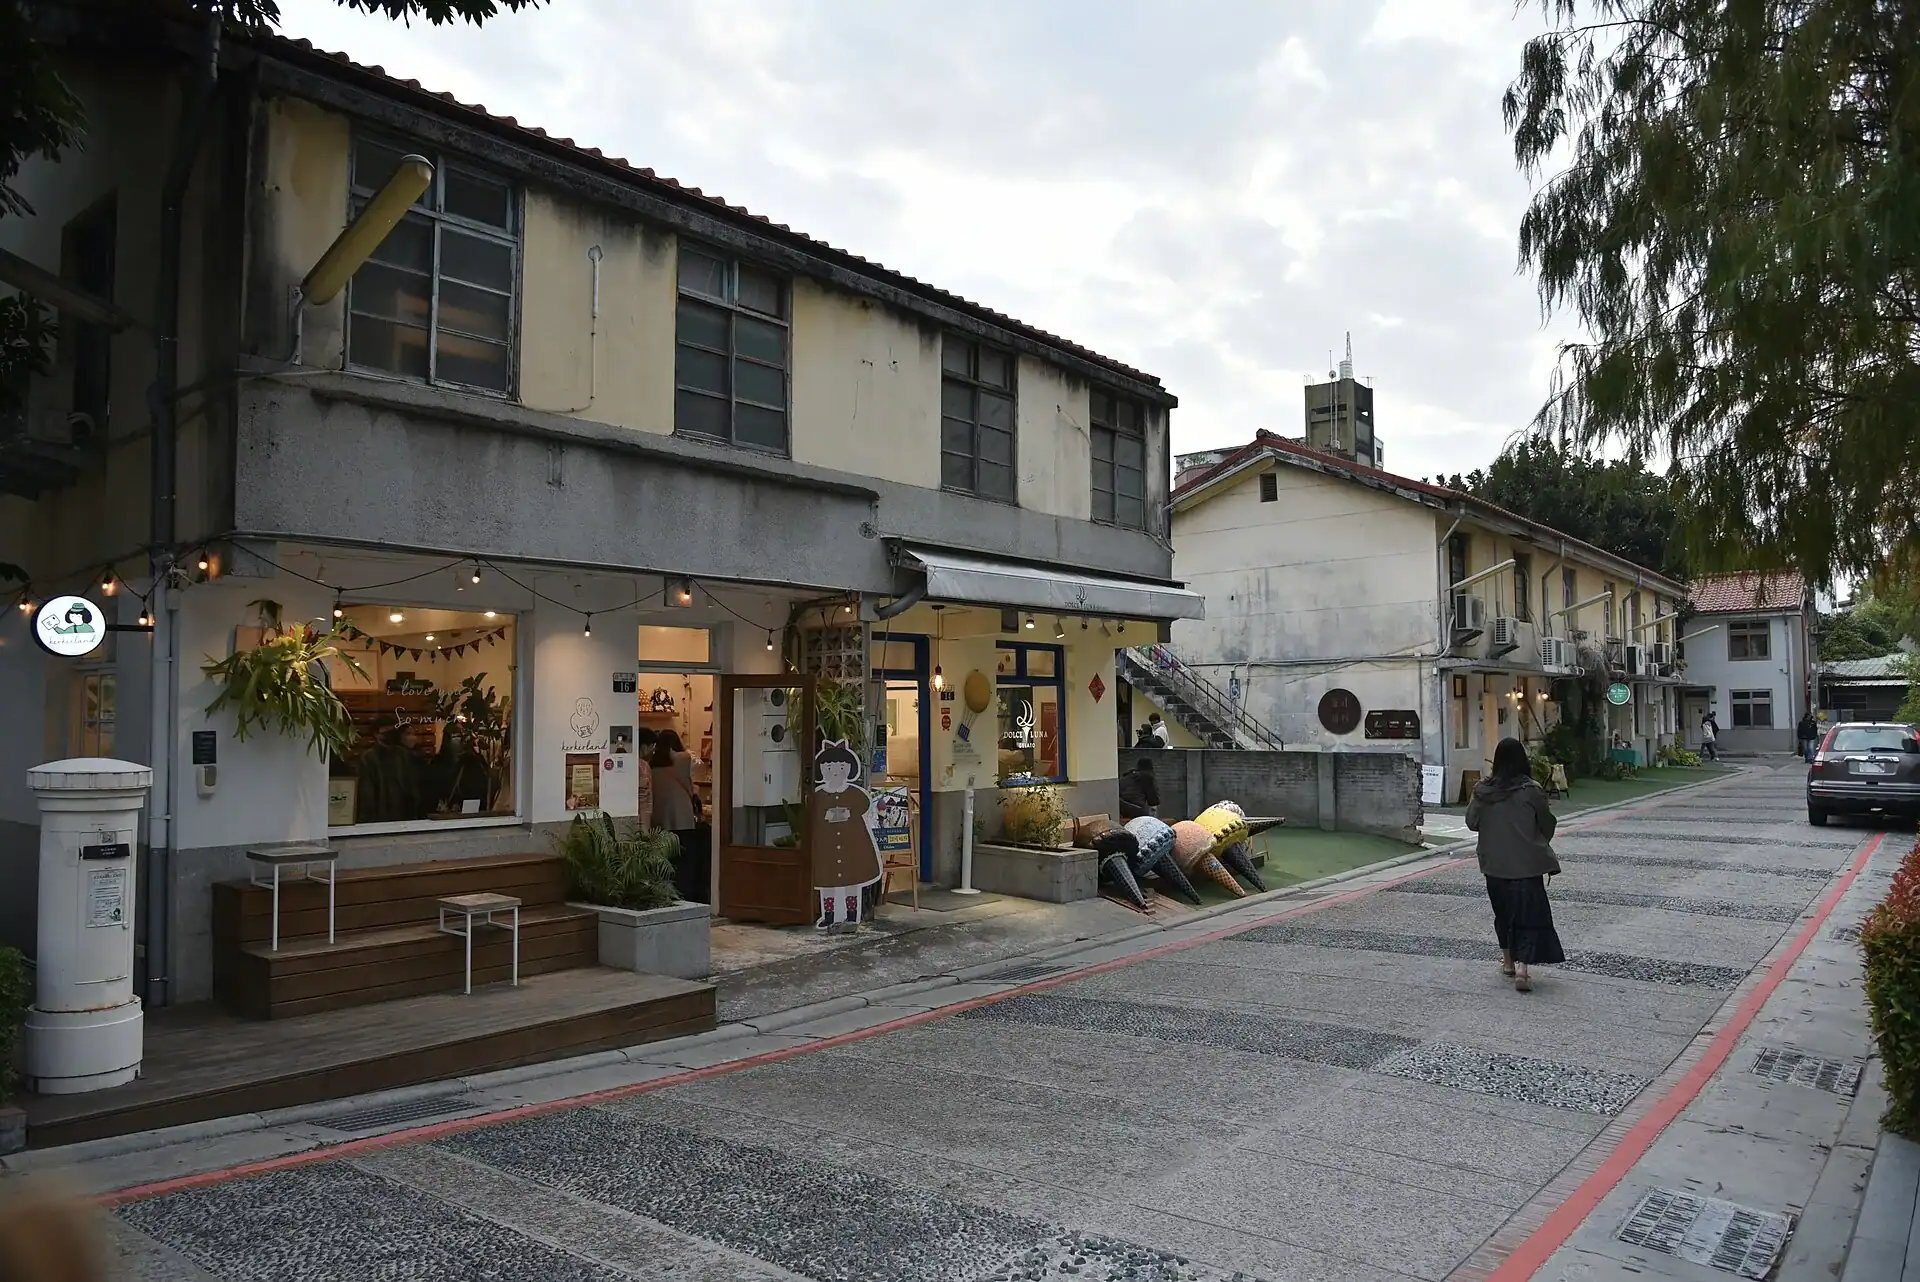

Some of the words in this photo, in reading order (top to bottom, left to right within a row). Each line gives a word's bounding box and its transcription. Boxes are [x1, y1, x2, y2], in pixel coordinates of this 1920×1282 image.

[401, 679, 431, 696] love
[620, 682, 630, 692] 16
[1003, 731, 1023, 739] DOLCE
[1030, 731, 1048, 739] LUNA
[561, 739, 608, 750] kerkerland
